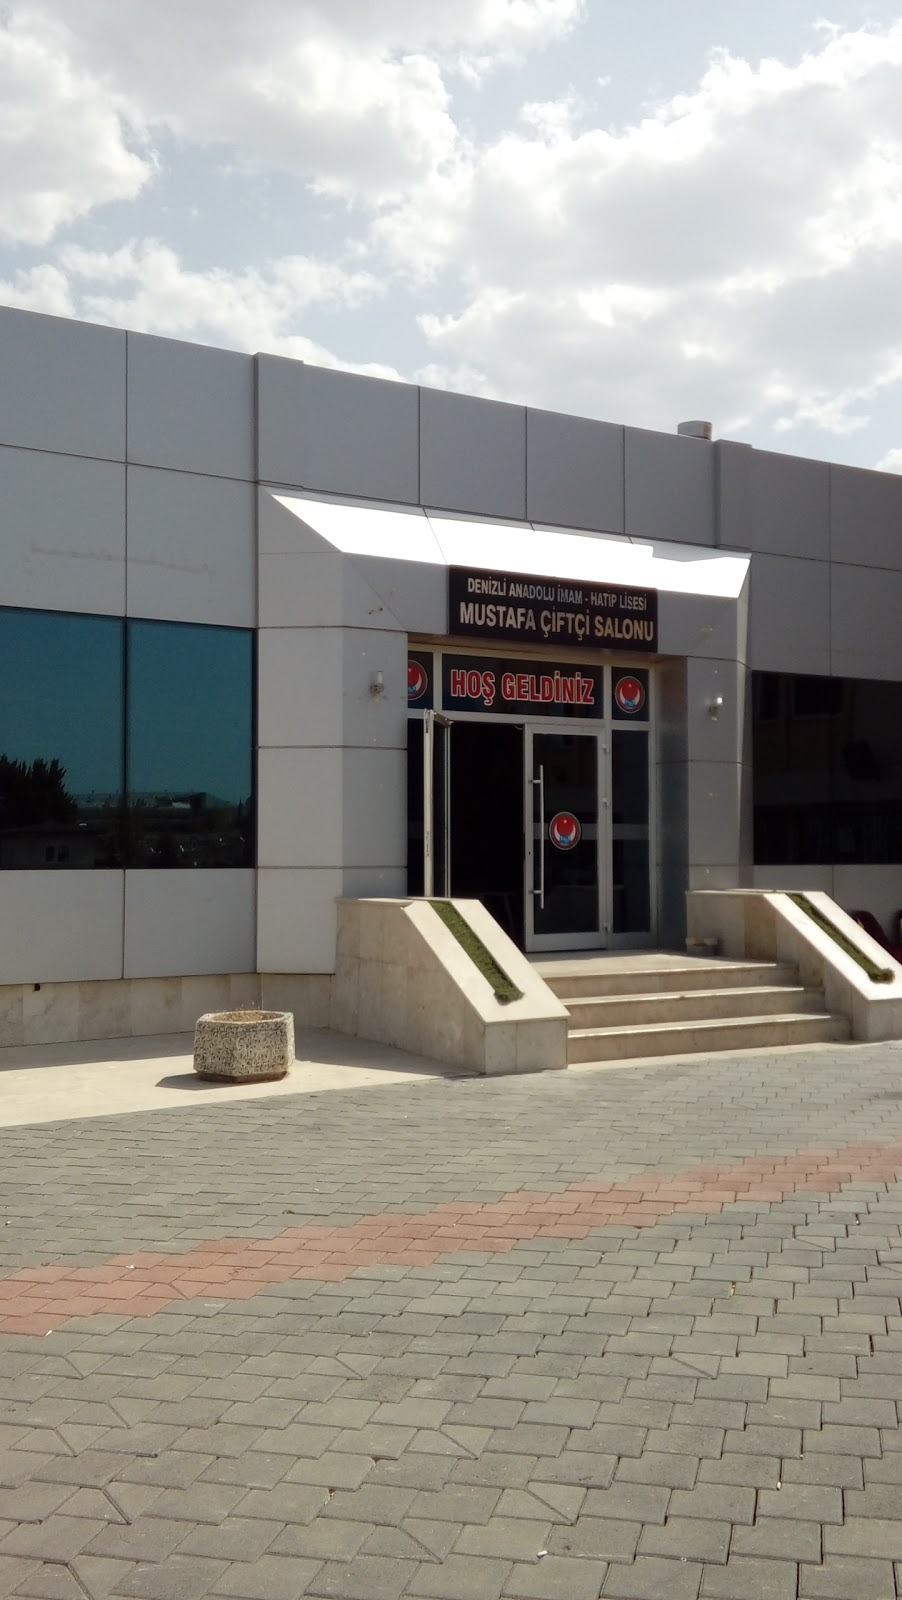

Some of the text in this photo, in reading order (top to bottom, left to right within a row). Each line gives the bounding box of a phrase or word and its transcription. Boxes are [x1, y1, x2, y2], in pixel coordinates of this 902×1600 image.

[467, 576, 507, 596] DENİZLİ
[509, 582, 555, 602] ANADOLU
[557, 584, 583, 605] İMAM
[590, 590, 617, 607] HATİP
[619, 593, 647, 611] LİSESİ
[459, 602, 654, 641] MUSTAFA ÇİFTÇİ SALONU
[450, 669, 594, 705] HOŞ GELDİNİZ
